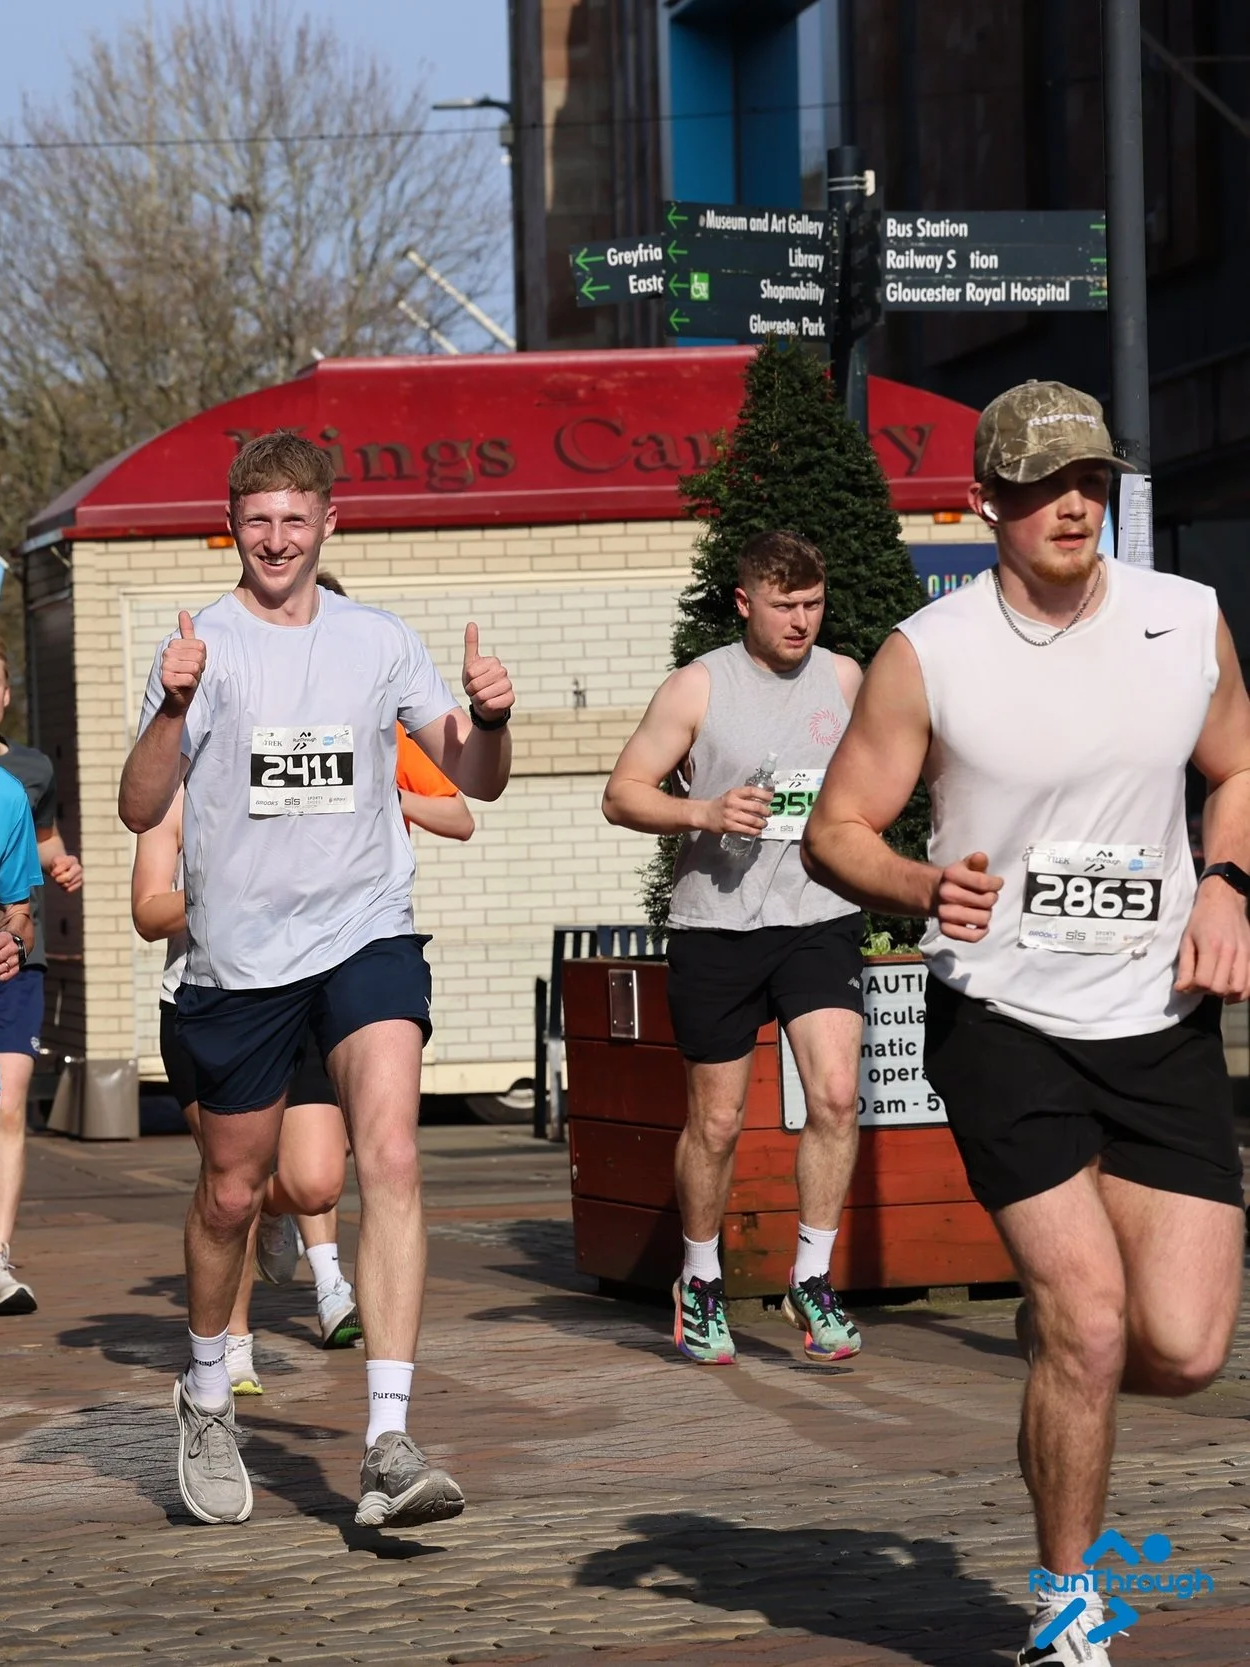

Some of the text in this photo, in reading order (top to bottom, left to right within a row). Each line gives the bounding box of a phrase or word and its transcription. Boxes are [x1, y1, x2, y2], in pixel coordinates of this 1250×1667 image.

[705, 209, 824, 239] Museum and Art Gallery
[886, 217, 968, 238] Bus Station
[606, 244, 663, 268] Greyfria
[788, 248, 824, 272] Library
[886, 249, 999, 274] Railway Stion
[760, 279, 825, 306] Shopmobility
[886, 281, 1070, 306] Gloucester Royal Hospital
[802, 316, 825, 337] Park
[224, 425, 516, 492] ings
[261, 753, 344, 787] 2411
[1030, 874, 1154, 920] 2863
[865, 974, 923, 995] AUTI
[873, 1099, 906, 1115] am
